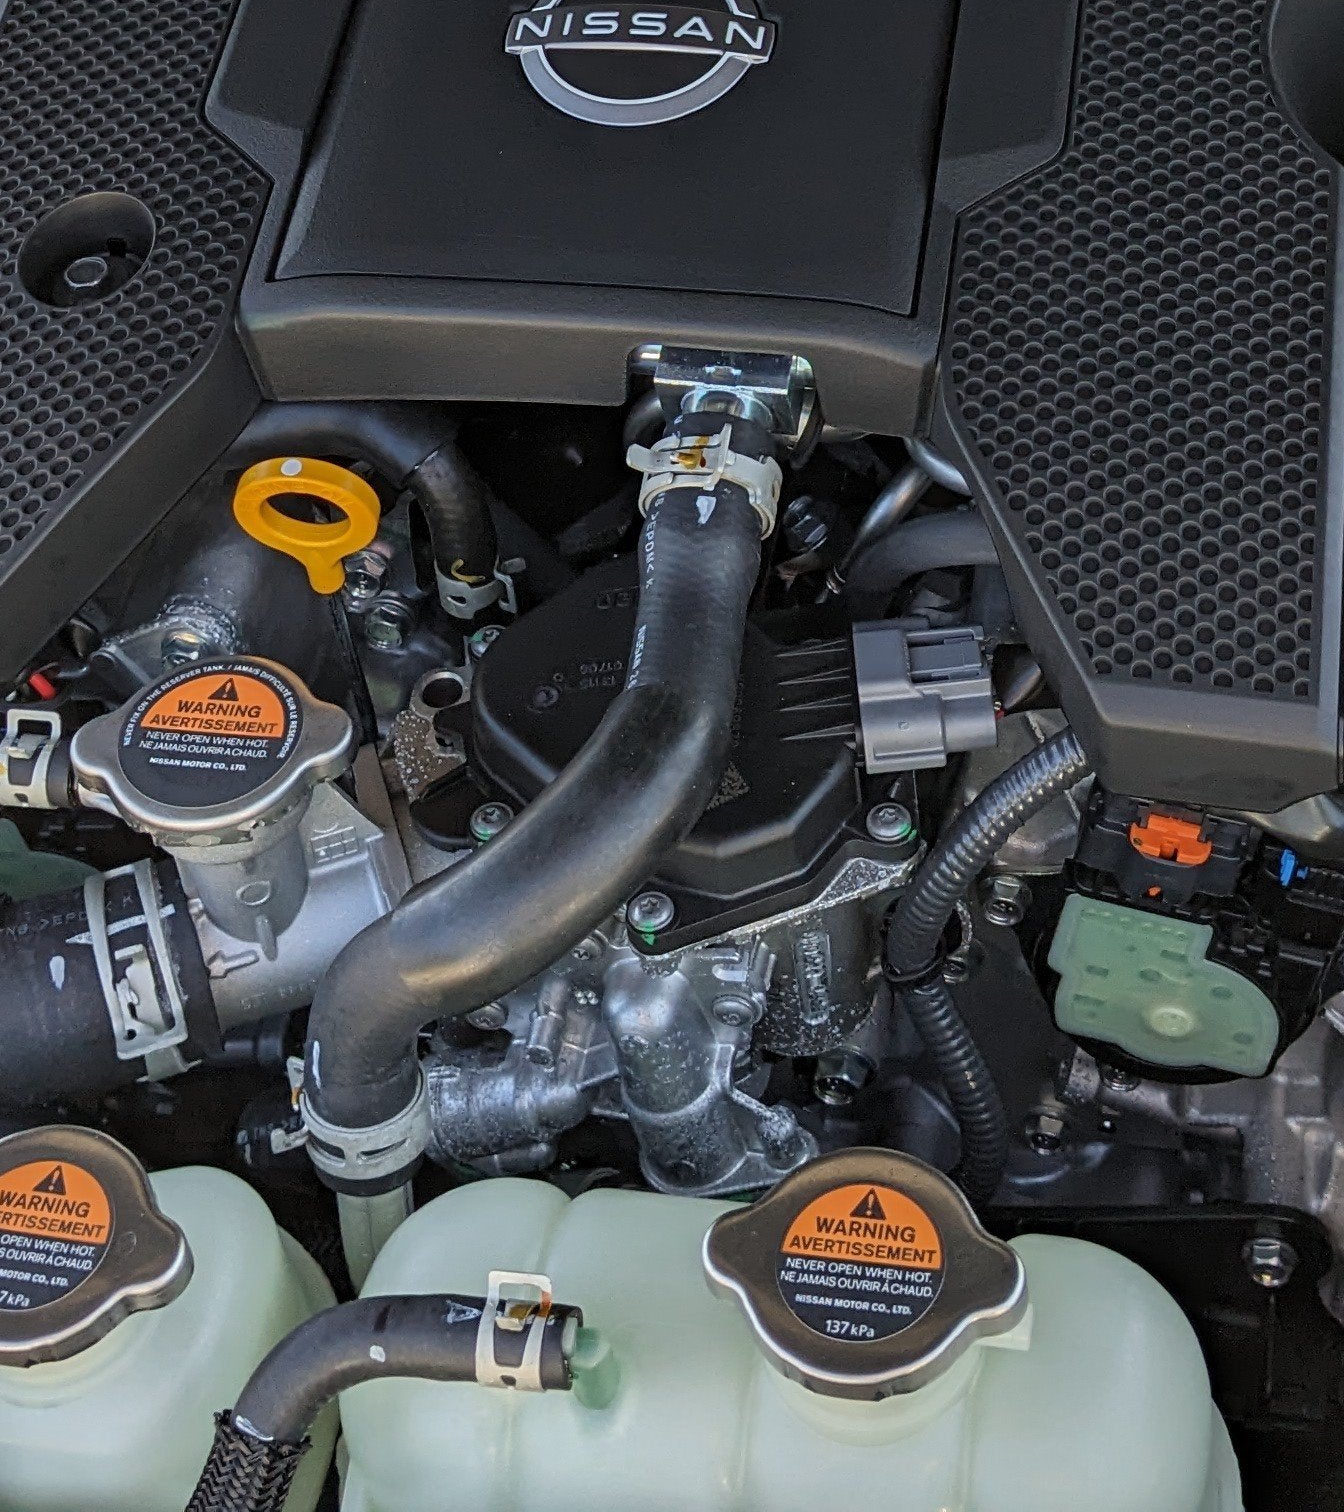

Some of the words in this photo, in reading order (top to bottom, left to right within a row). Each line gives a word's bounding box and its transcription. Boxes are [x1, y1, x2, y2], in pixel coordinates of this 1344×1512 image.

[514, 10, 766, 50] NISSAN
[146, 689, 162, 703] THE
[177, 699, 262, 718] WARNING
[149, 713, 278, 734] AVERTISSEMENT
[138, 740, 154, 749] NE
[153, 742, 187, 753] JAMAIS
[187, 745, 224, 755] OUVRIR
[146, 730, 180, 742] NEVER
[181, 733, 210, 744] OPEN
[212, 736, 245, 747] WHEN
[245, 739, 269, 749] HOT.
[149, 757, 181, 767] NISSAN
[181, 759, 212, 769] MOTOR
[816, 1215, 916, 1244] WARNING
[0, 1233, 32, 1247] OPEN
[34, 1238, 69, 1253] WHEN
[70, 1243, 96, 1257] HOT.
[789, 1234, 937, 1264] AVERTISSEMENT
[6, 1248, 46, 1264] OUVRIR
[54, 1255, 93, 1271] CHAUD.
[785, 1257, 826, 1272] NEVER
[828, 1261, 863, 1276] OPEN
[864, 1266, 903, 1281] WHEN
[905, 1271, 933, 1283] HOT.
[50, 1277, 69, 1287] LTD.
[780, 1270, 797, 1282] NE
[796, 1273, 837, 1288] JAMAIS
[837, 1277, 882, 1293] OUVRIR
[890, 1283, 935, 1298] CHAUD.
[795, 1293, 834, 1306] NISSAN
[833, 1298, 870, 1311] MOTOR
[892, 1304, 913, 1316] LTD.
[825, 1319, 850, 1334] 137
[850, 1323, 875, 1338] kPa
